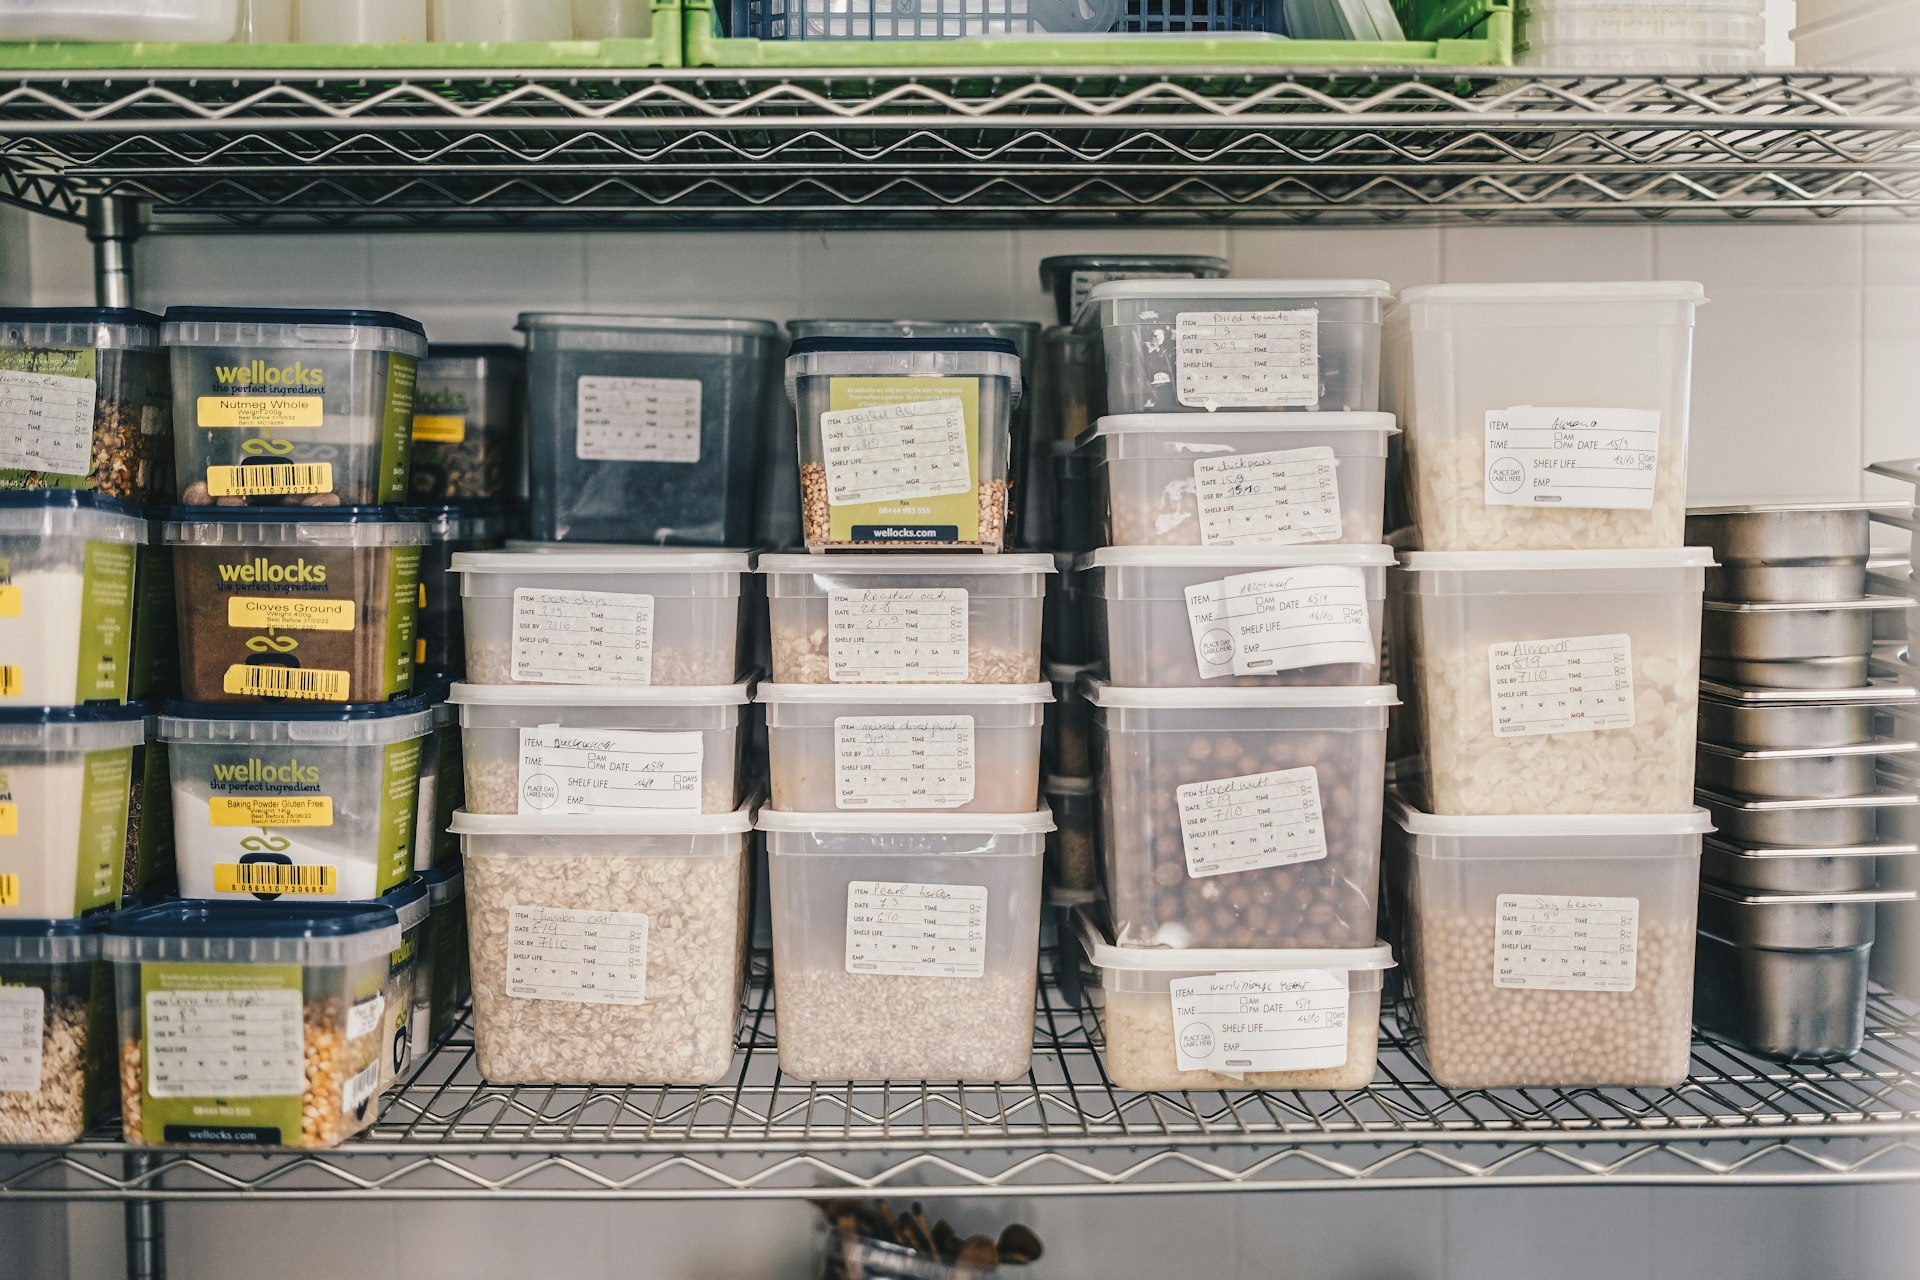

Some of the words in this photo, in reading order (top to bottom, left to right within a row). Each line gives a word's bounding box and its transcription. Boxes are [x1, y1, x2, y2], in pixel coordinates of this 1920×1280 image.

[215, 360, 323, 385] wellocks
[212, 382, 229, 392] the
[231, 384, 267, 395] perfect
[269, 384, 325, 397] ingredient
[220, 401, 266, 410] Nutmeg
[270, 401, 309, 409] Whole
[1489, 421, 1509, 430] ITEM
[1489, 441, 1508, 449] TIME
[1577, 441, 1598, 450] DATE
[1533, 459, 1557, 468] SHELF
[1559, 459, 1576, 468] LIFE
[873, 527, 937, 538] wellocks.com
[218, 558, 326, 583] wellocks
[216, 582, 232, 591] the
[235, 582, 271, 594] perfect
[273, 582, 329, 594] ingredient
[1191, 595, 1210, 606] ITEM
[246, 602, 289, 611] Cloves
[294, 604, 342, 613] Ground
[1280, 601, 1300, 611] DATE
[1194, 614, 1214, 624] TIME
[1240, 624, 1264, 636] SHELF
[1265, 622, 1281, 631] LIFE
[524, 739, 543, 747] ITEM
[525, 757, 542, 766] TIME
[213, 758, 319, 783] wellocks
[610, 763, 629, 771] DATE
[210, 779, 226, 790] the
[228, 781, 263, 793] perfect
[265, 781, 321, 794] ingredient
[568, 778, 592, 787] SHELF
[593, 780, 608, 788] LIFE
[228, 800, 251, 809] Baking
[1176, 989, 1194, 997] ITEM
[1177, 1007, 1196, 1016] TIME
[1263, 1004, 1284, 1013] DATE
[1222, 1024, 1246, 1033] SHELF
[1247, 1024, 1263, 1032] LIFE
[189, 1130, 256, 1140] wellocks.com
